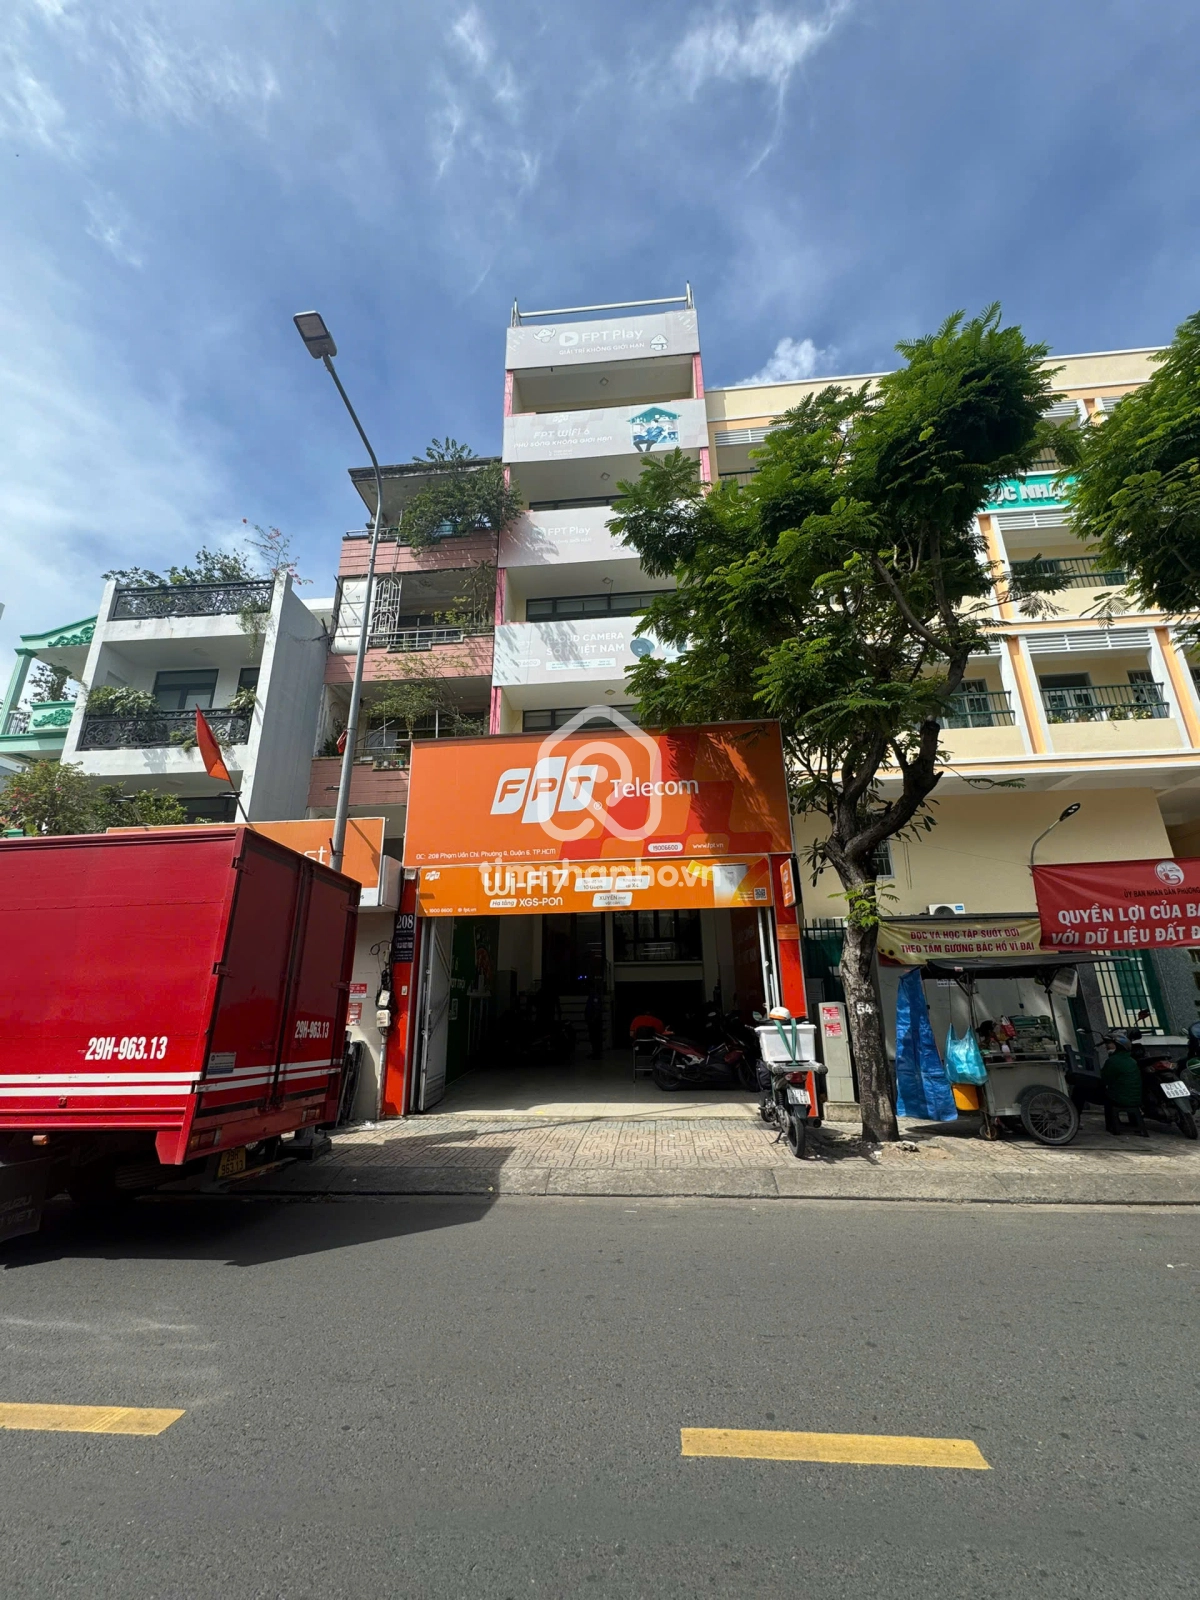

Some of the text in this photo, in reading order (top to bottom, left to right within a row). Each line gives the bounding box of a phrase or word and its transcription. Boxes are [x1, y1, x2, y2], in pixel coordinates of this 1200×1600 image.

[581, 329, 645, 343] FPT Play
[533, 430, 556, 440] FPT
[583, 427, 591, 436] 6
[547, 525, 591, 537] FPT Play
[582, 631, 625, 642] CAMERA
[573, 644, 597, 656] VIỆT
[599, 642, 625, 653] NAM
[490, 756, 700, 824] FPT Telecom
[483, 869, 570, 897] Wi-Fi 7
[1133, 890, 1147, 899] BAN
[1147, 888, 1165, 898] NHÂN
[1164, 887, 1178, 896] DÂN
[1058, 903, 1114, 927] QUYỀN
[1118, 904, 1146, 923] LỢI
[1149, 900, 1183, 920] CỦA
[395, 914, 414, 929] 208
[910, 930, 928, 941] ĐỌC
[942, 930, 960, 941] HỌC
[961, 928, 979, 940] TẬP
[980, 927, 1003, 939] SUỐT
[1051, 928, 1080, 945] VỚI
[1084, 927, 1109, 945] DỮ
[1113, 925, 1150, 946] LIỆU
[1154, 921, 1186, 941] ĐẤT
[901, 944, 922, 954] THEO
[923, 942, 943, 954] TẤM
[944, 943, 974, 953] GƯƠNG
[975, 941, 994, 952] BÁC
[995, 939, 1008, 951] HỒ
[1020, 941, 1035, 953] ĐẠI
[856, 1003, 873, 1015] 54
[294, 1019, 330, 1039] 29H-963.13
[84, 1035, 169, 1061] 29H-963.13
[226, 1149, 240, 1162] 29H
[221, 1160, 244, 1175] 963.13
